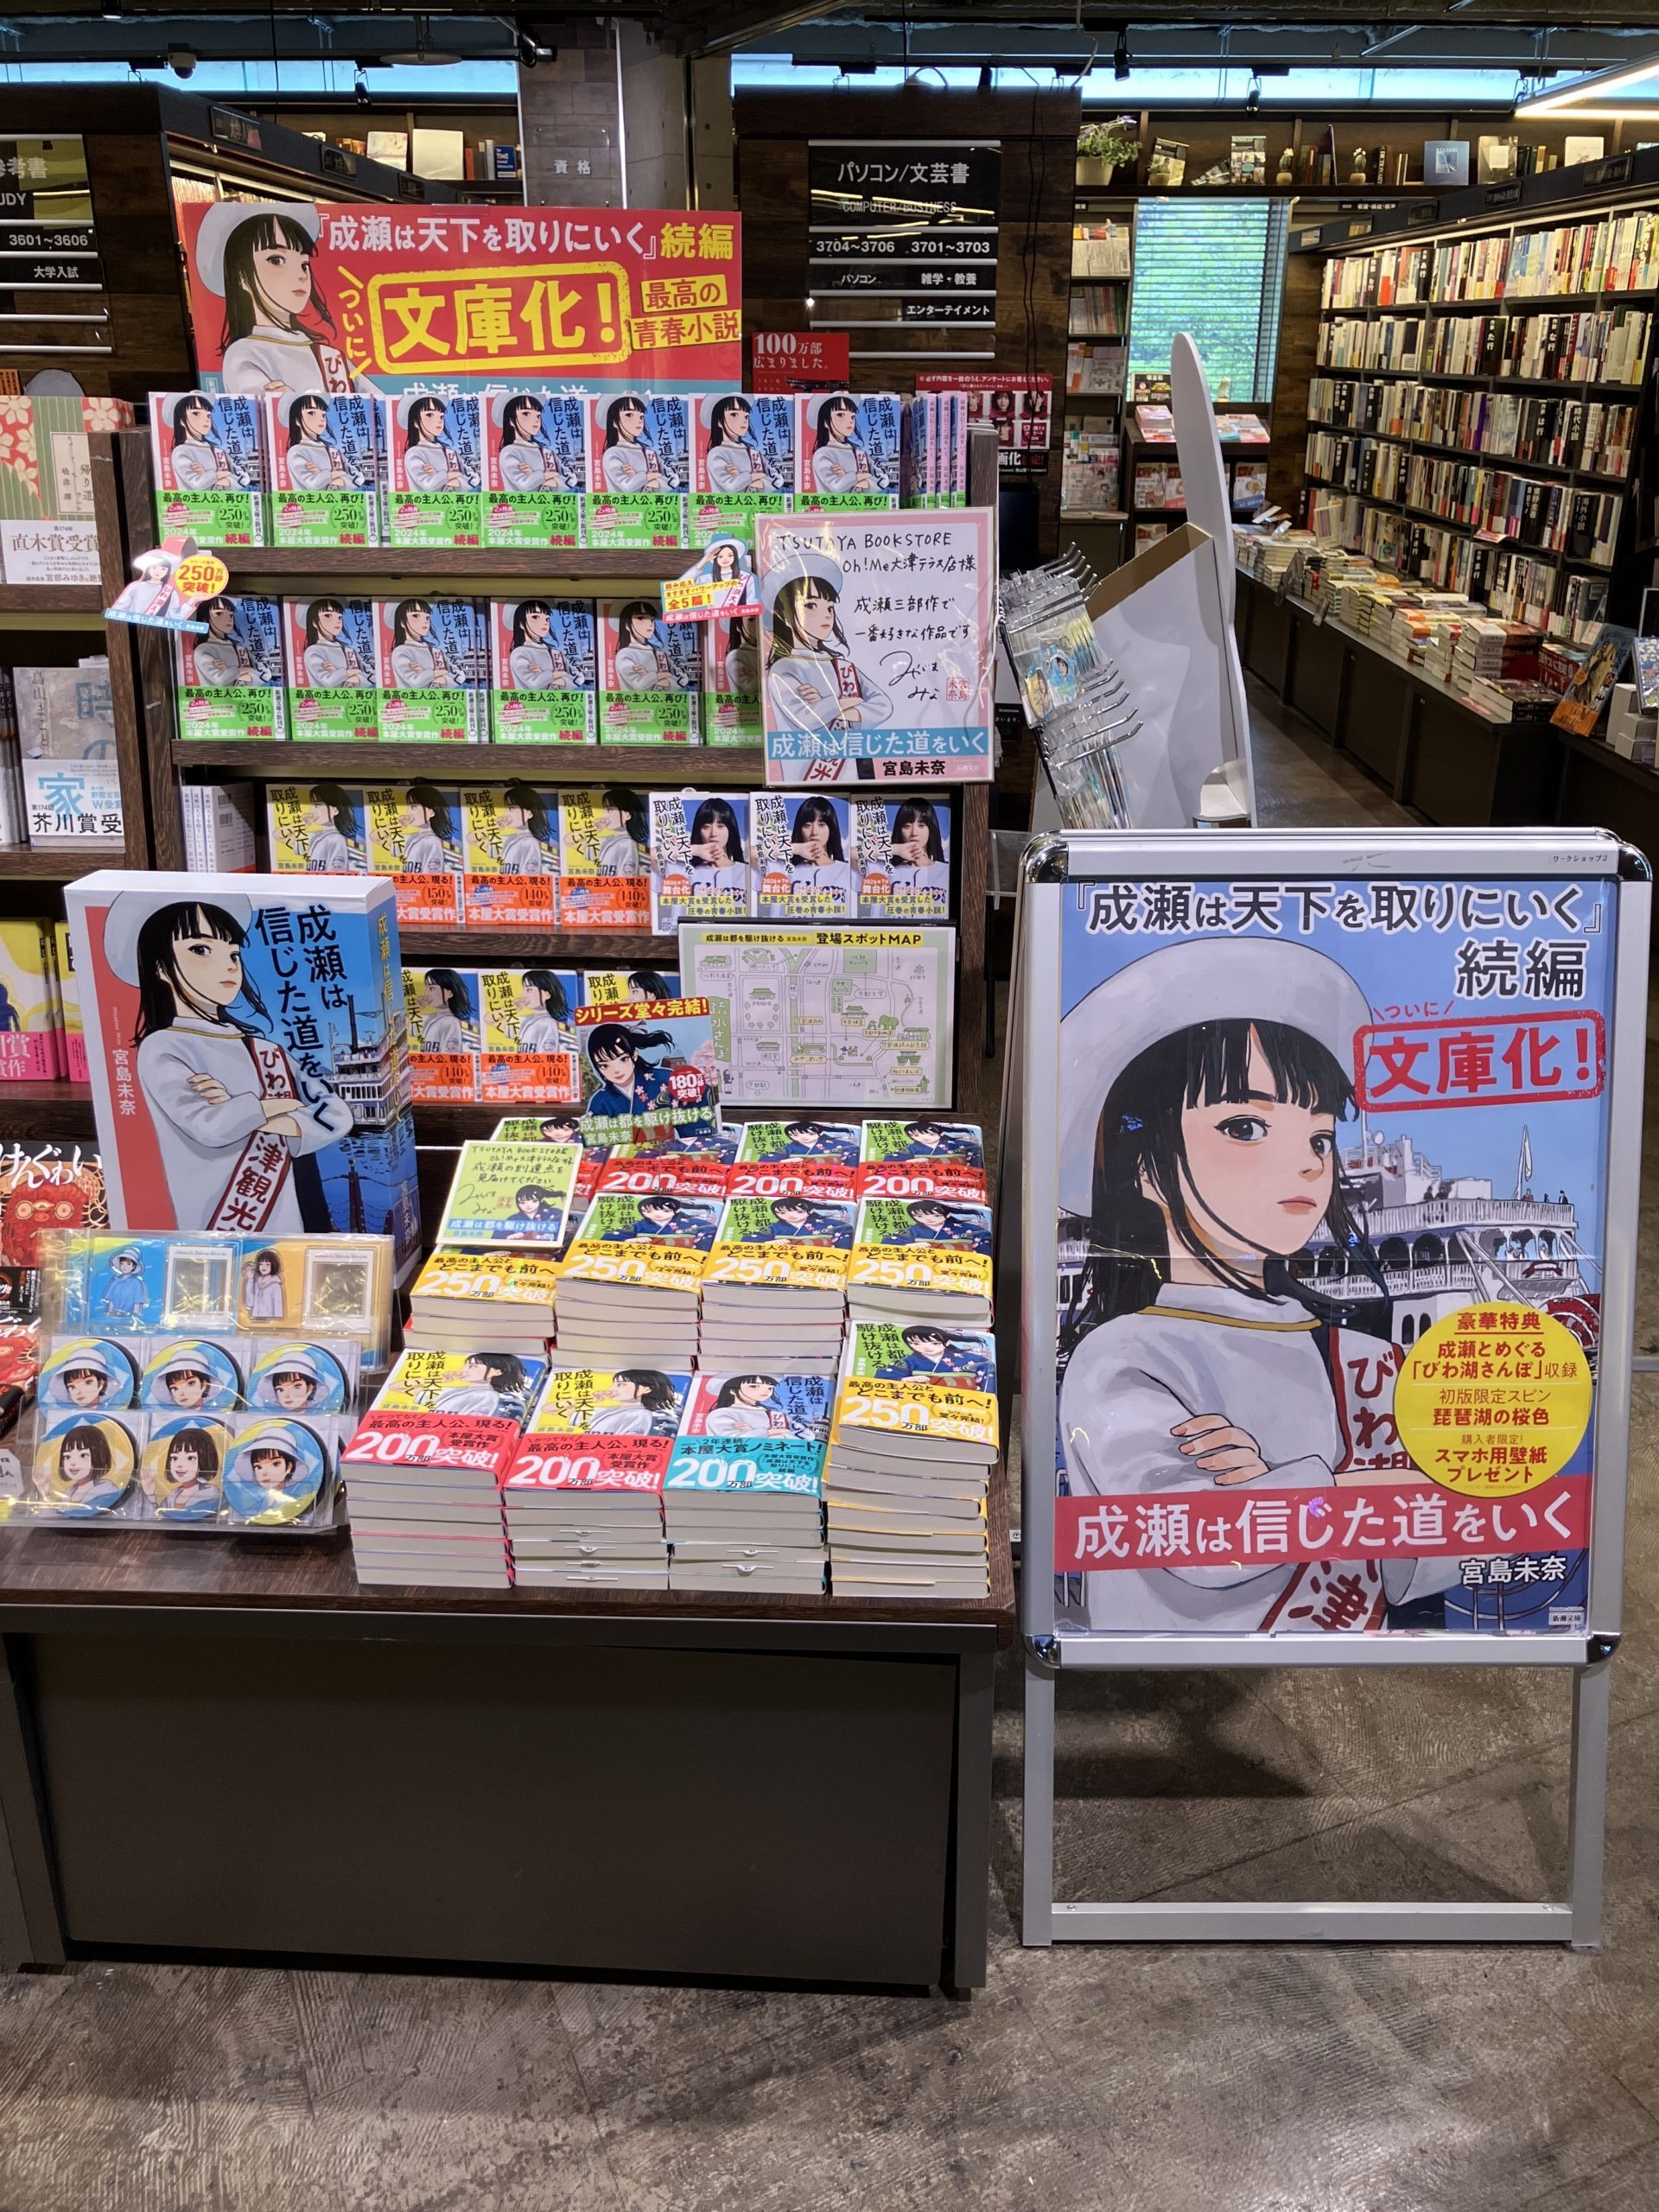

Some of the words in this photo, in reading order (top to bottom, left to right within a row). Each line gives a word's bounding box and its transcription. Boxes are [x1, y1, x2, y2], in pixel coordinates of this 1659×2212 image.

[837, 162, 970, 184] パソコン/文芸書
[842, 200, 957, 214] COMPUTER/BUSINESS
[33, 265, 79, 278] 大学入試
[841, 273, 877, 284] パソコン
[920, 273, 977, 286] 雑学・教養
[646, 281, 721, 309] 最高の
[339, 289, 368, 357] ついに
[906, 304, 990, 316] エンターテイメント
[632, 312, 741, 346] 青春小説
[234, 395, 253, 437] 成瀬は
[348, 395, 368, 437] 成瀬は
[564, 397, 582, 439] 成瀬は
[217, 396, 251, 489] 信じた道をいく
[333, 396, 365, 489] 信じた道をいく
[548, 397, 575, 489] 信じた道をいく
[651, 397, 678, 490] 信じた道をいく
[863, 397, 889, 490] 信じた道をいく
[162, 493, 250, 505] 最高の主人公、再び!
[277, 493, 365, 505] 最高の主人公、再び!
[488, 493, 576, 505] 最高の主人公、再び!
[592, 494, 678, 505] 最高の主人公、再び!
[801, 495, 887, 506] 最高の主人公、再び!
[854, 594, 955, 613] 成瀬三部作で
[855, 623, 970, 643] 一番好きな作品です
[772, 728, 986, 758] 成瀬は信じた道をいく
[882, 760, 946, 776] 宮島未奈
[32, 813, 123, 835] 芥川賞受
[270, 789, 294, 850] 取りにいく
[284, 786, 312, 862] 成瀬は天下を
[464, 792, 488, 853] 取りにいく
[479, 790, 505, 864] 成瀬は天下を
[563, 793, 585, 855] 取りにいく
[576, 791, 602, 868] 成瀬は天下を
[653, 799, 677, 863] 取りにいく
[756, 798, 777, 861] 取りにいく
[668, 797, 694, 875] 成瀬は天下を
[771, 795, 794, 874] 成瀬は天下を
[471, 875, 550, 886] 最高の主人公、現る!
[567, 878, 647, 888] 最高の主人公、現る!
[1077, 880, 1602, 933] 『成瀬は天下を取りにいく』
[817, 932, 922, 945] 登場スポットMAP
[297, 903, 348, 1009] 成瀬は
[1457, 939, 1587, 998] 続編
[482, 975, 505, 1033] 取りにいく
[497, 971, 523, 1046] 成瀬は天下を
[575, 999, 708, 1025] シリーズ堂々完結!
[1384, 1001, 1442, 1019] ついに
[255, 906, 337, 1134] 信じた道をいく
[488, 1054, 568, 1064] 最高の主人公、現る!
[112, 1048, 137, 1116] 宮島未奈
[580, 1107, 713, 1131] 成瀬は都を駆け抜ける
[449, 1219, 557, 1231] 成瀬は都を駆け抜ける
[1457, 1312, 1541, 1331] 豪華特典
[856, 1323, 887, 1369] 駆け抜ける
[877, 1323, 906, 1369] 成瀬は都を
[1438, 1341, 1546, 1359] 成瀬とめぐる
[1413, 1361, 1578, 1380] 「びわ湖さんぽ」収録
[804, 1376, 825, 1407] 成瀬は
[848, 1380, 934, 1393] 最高の主人公と
[856, 1387, 993, 1409] どこまでも前へ!
[1440, 1388, 1552, 1405] 初版限定スピン
[368, 1418, 512, 1430] 最高の主人公、現る!
[842, 1396, 930, 1427] 250
[1433, 1408, 1549, 1427] 琵琶湖の桜色
[347, 1431, 441, 1459] 200
[434, 1448, 499, 1468] 突破!
[448, 1432, 499, 1442] 本屋大賞
[525, 1439, 670, 1452] 最高の主人公、現る!
[681, 1442, 823, 1455] 本屋大賞ノミネート!
[607, 1452, 658, 1462] 本屋大賞
[1435, 1446, 1548, 1465] スマホ用壁紙
[509, 1454, 600, 1484] 200
[595, 1469, 661, 1490] 突破!
[668, 1458, 757, 1487] 200
[755, 1471, 819, 1493] 突破!
[1447, 1467, 1534, 1484] プレゼント
[1074, 1491, 1573, 1560] 成瀬は信じた道をいく
[1460, 1555, 1567, 1585] 宮島未奈
